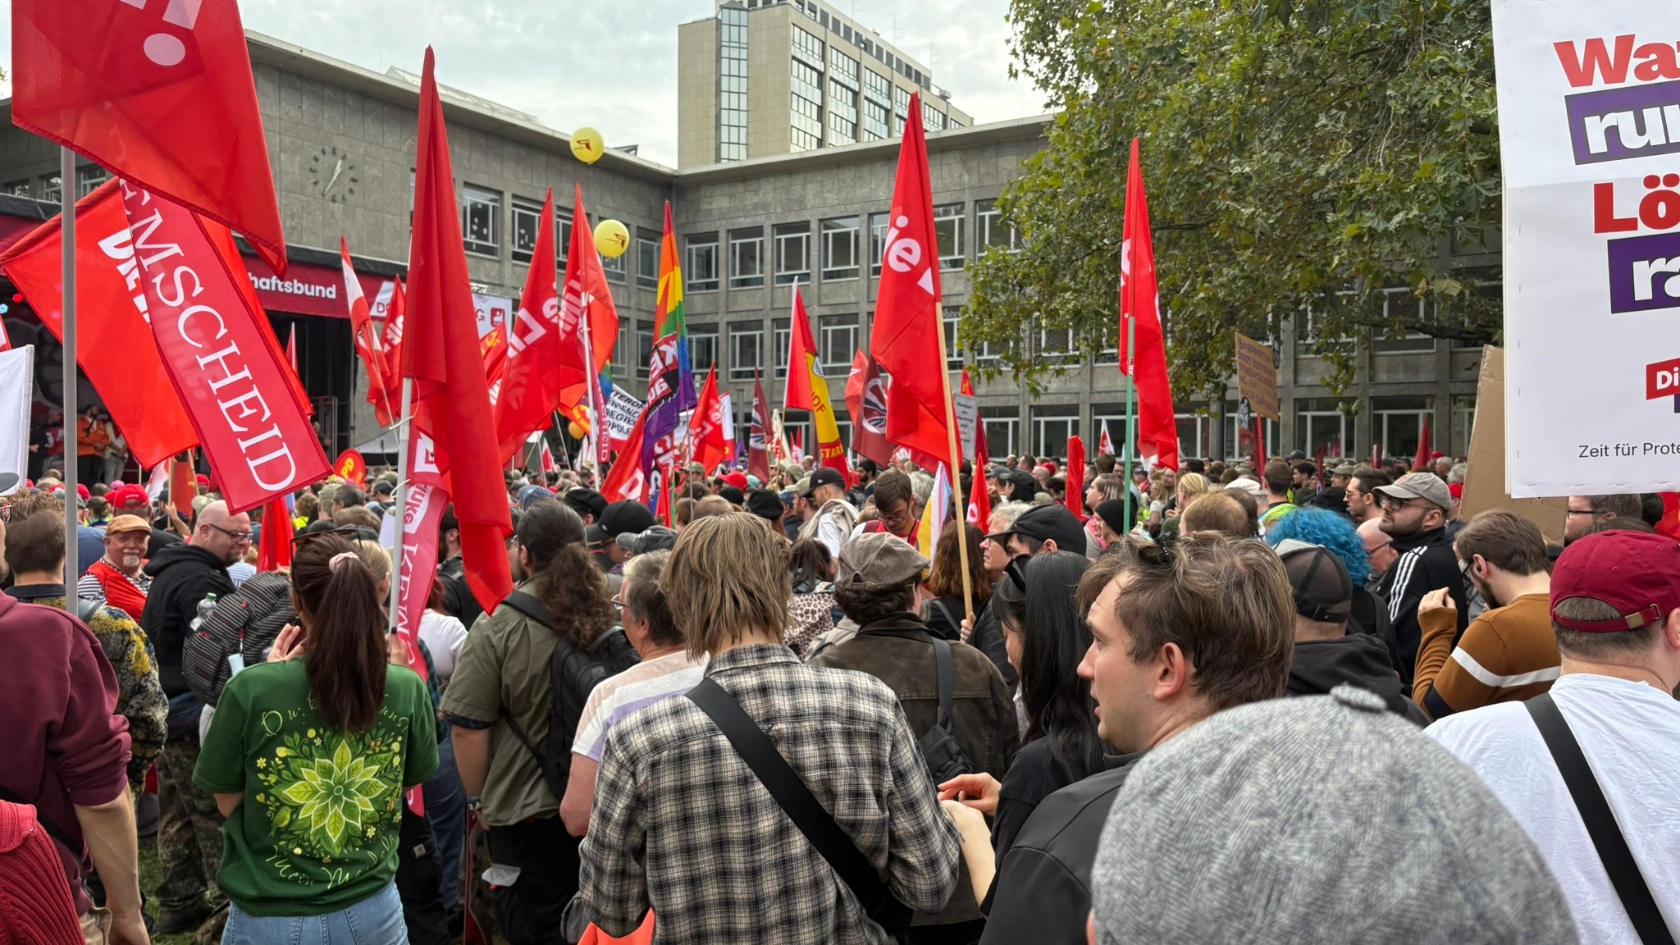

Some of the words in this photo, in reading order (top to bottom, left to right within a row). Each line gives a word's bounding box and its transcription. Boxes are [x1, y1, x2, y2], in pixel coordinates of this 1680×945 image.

[1553, 34, 1680, 88] Wa
[248, 272, 336, 299] haftsbund
[1578, 444, 1609, 458] Zeit
[1614, 443, 1637, 456] für
